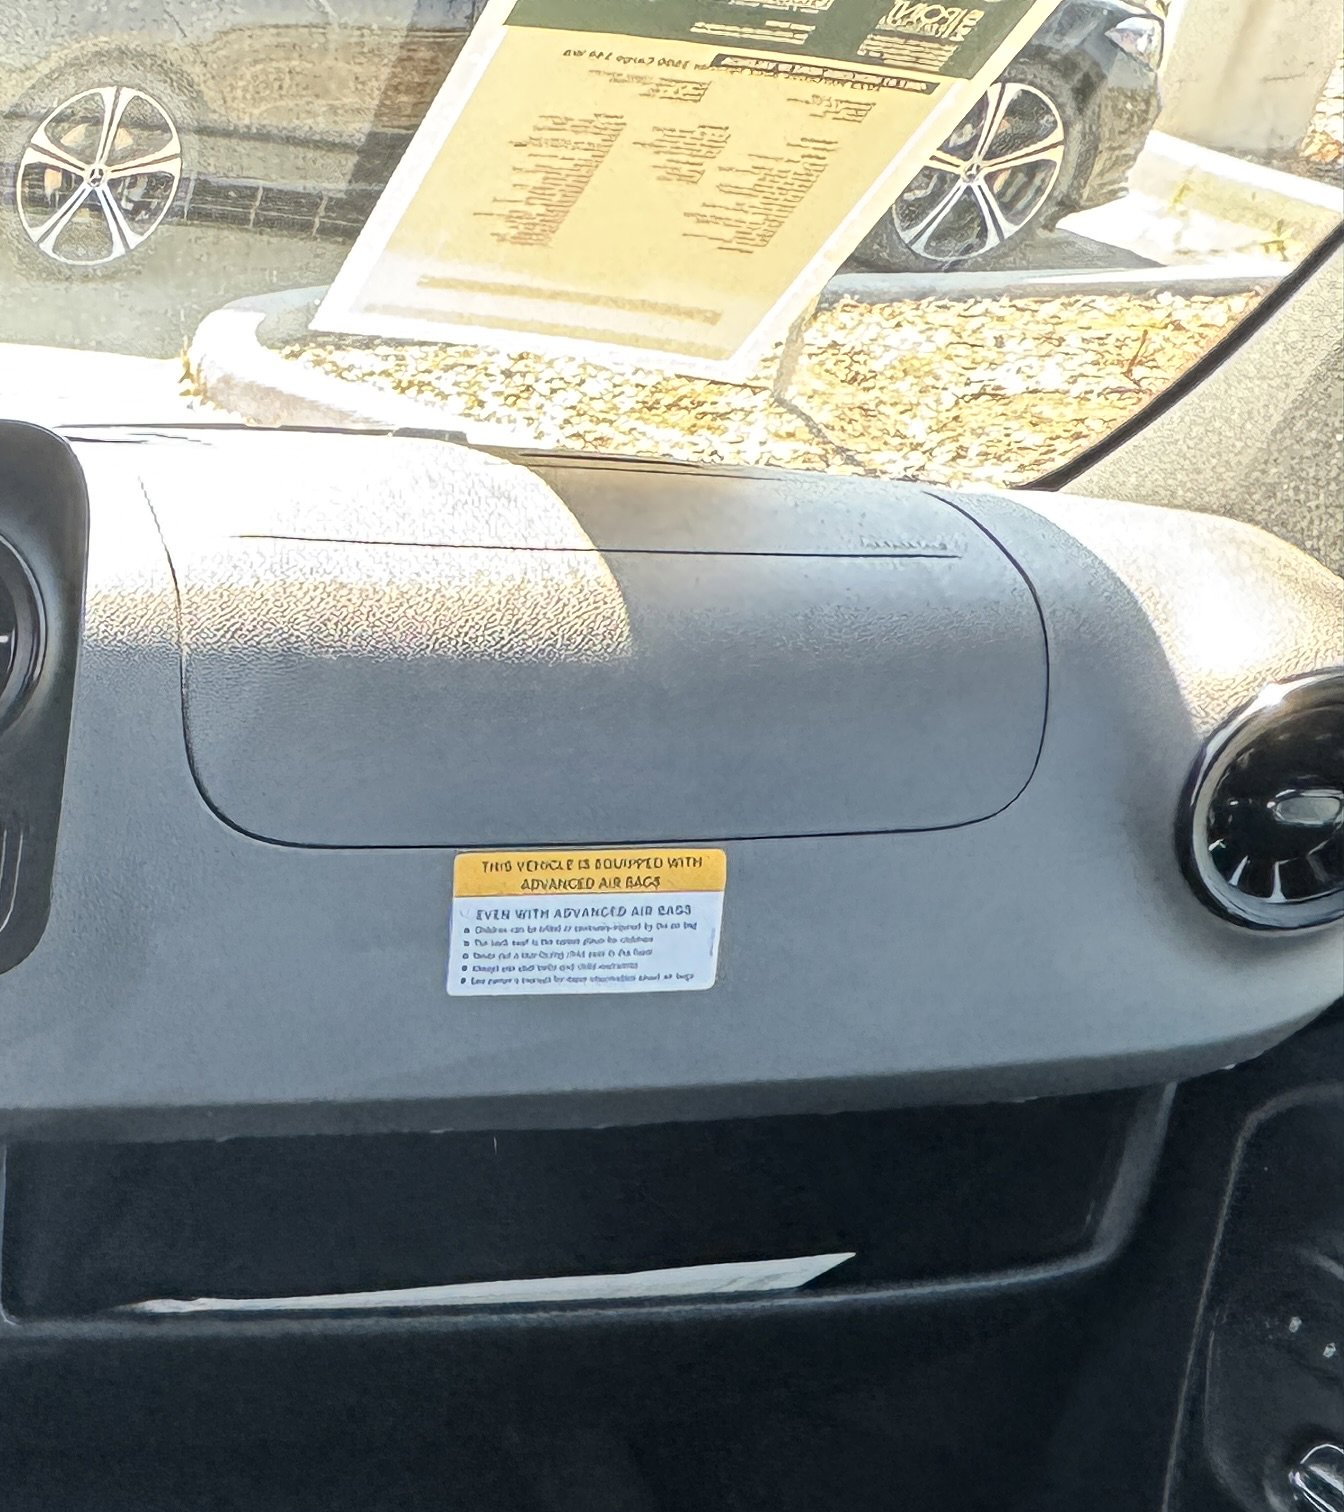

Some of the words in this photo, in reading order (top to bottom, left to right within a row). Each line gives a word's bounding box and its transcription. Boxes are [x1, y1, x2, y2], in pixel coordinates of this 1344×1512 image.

[667, 856, 703, 868] WITH
[520, 877, 595, 891] ADVANCED
[598, 876, 622, 889] AIR
[515, 907, 550, 920] WITH
